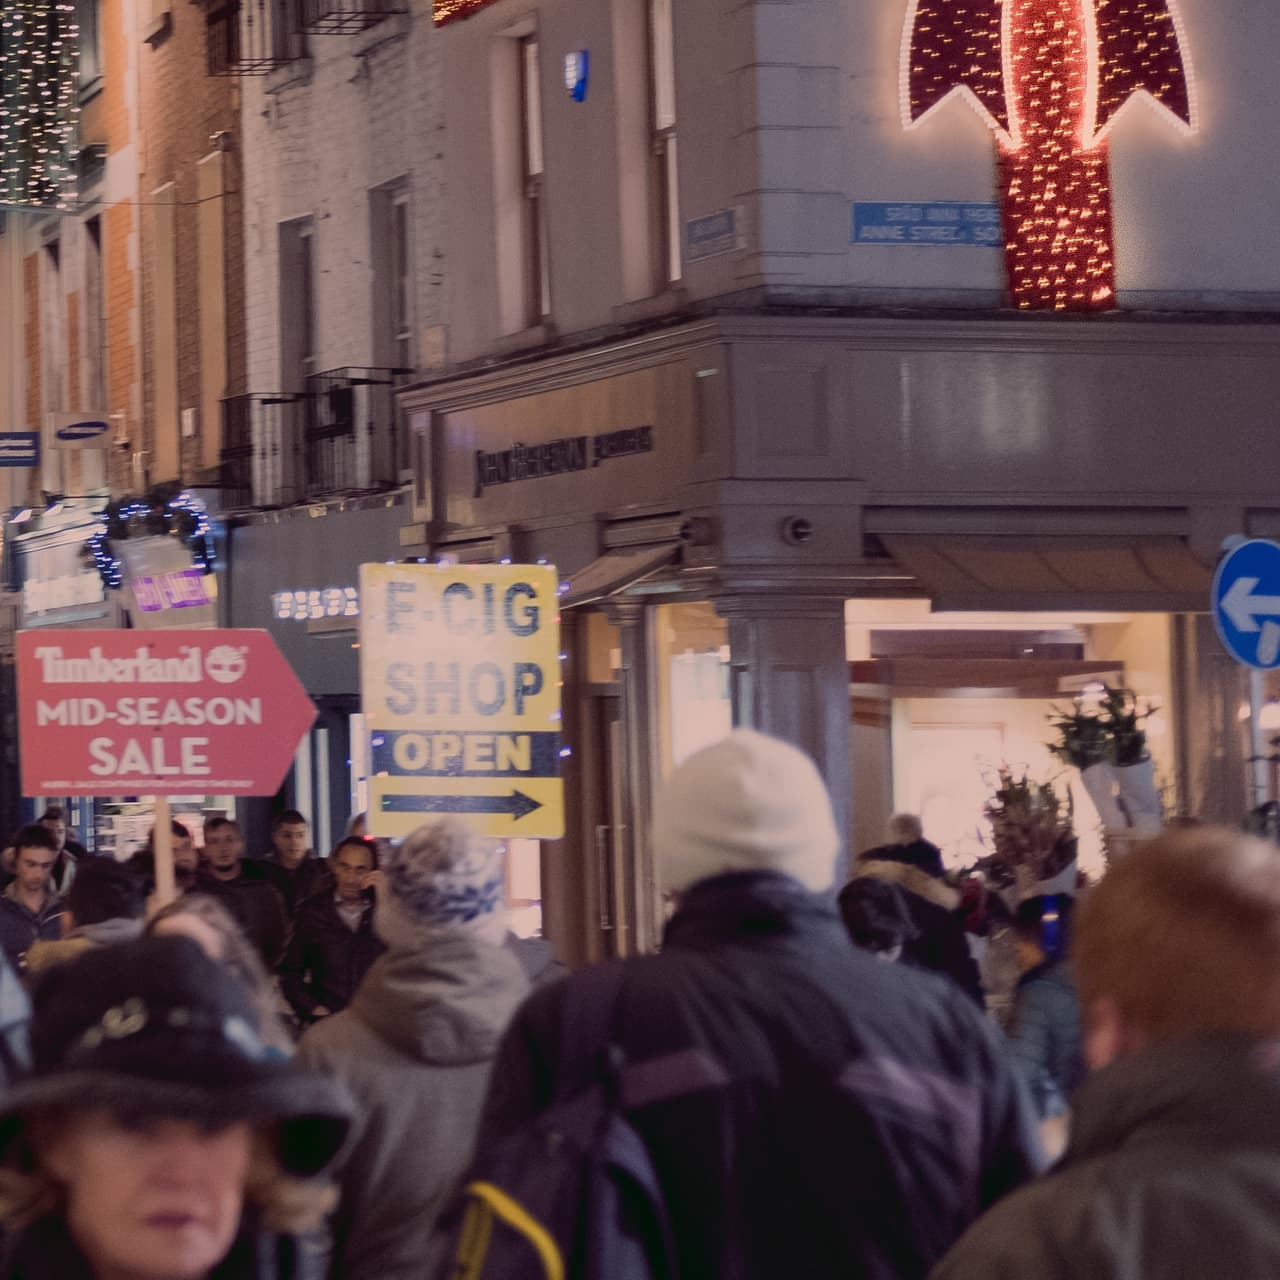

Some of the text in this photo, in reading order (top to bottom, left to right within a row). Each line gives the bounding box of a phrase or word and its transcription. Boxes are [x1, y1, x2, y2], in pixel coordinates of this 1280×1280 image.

[386, 581, 541, 637] E-CIG
[34, 645, 202, 683] Timberland
[385, 662, 544, 716] SHOP
[36, 696, 262, 727] MID-SEASON
[88, 737, 212, 776] SALE
[393, 734, 532, 772] OPEN
